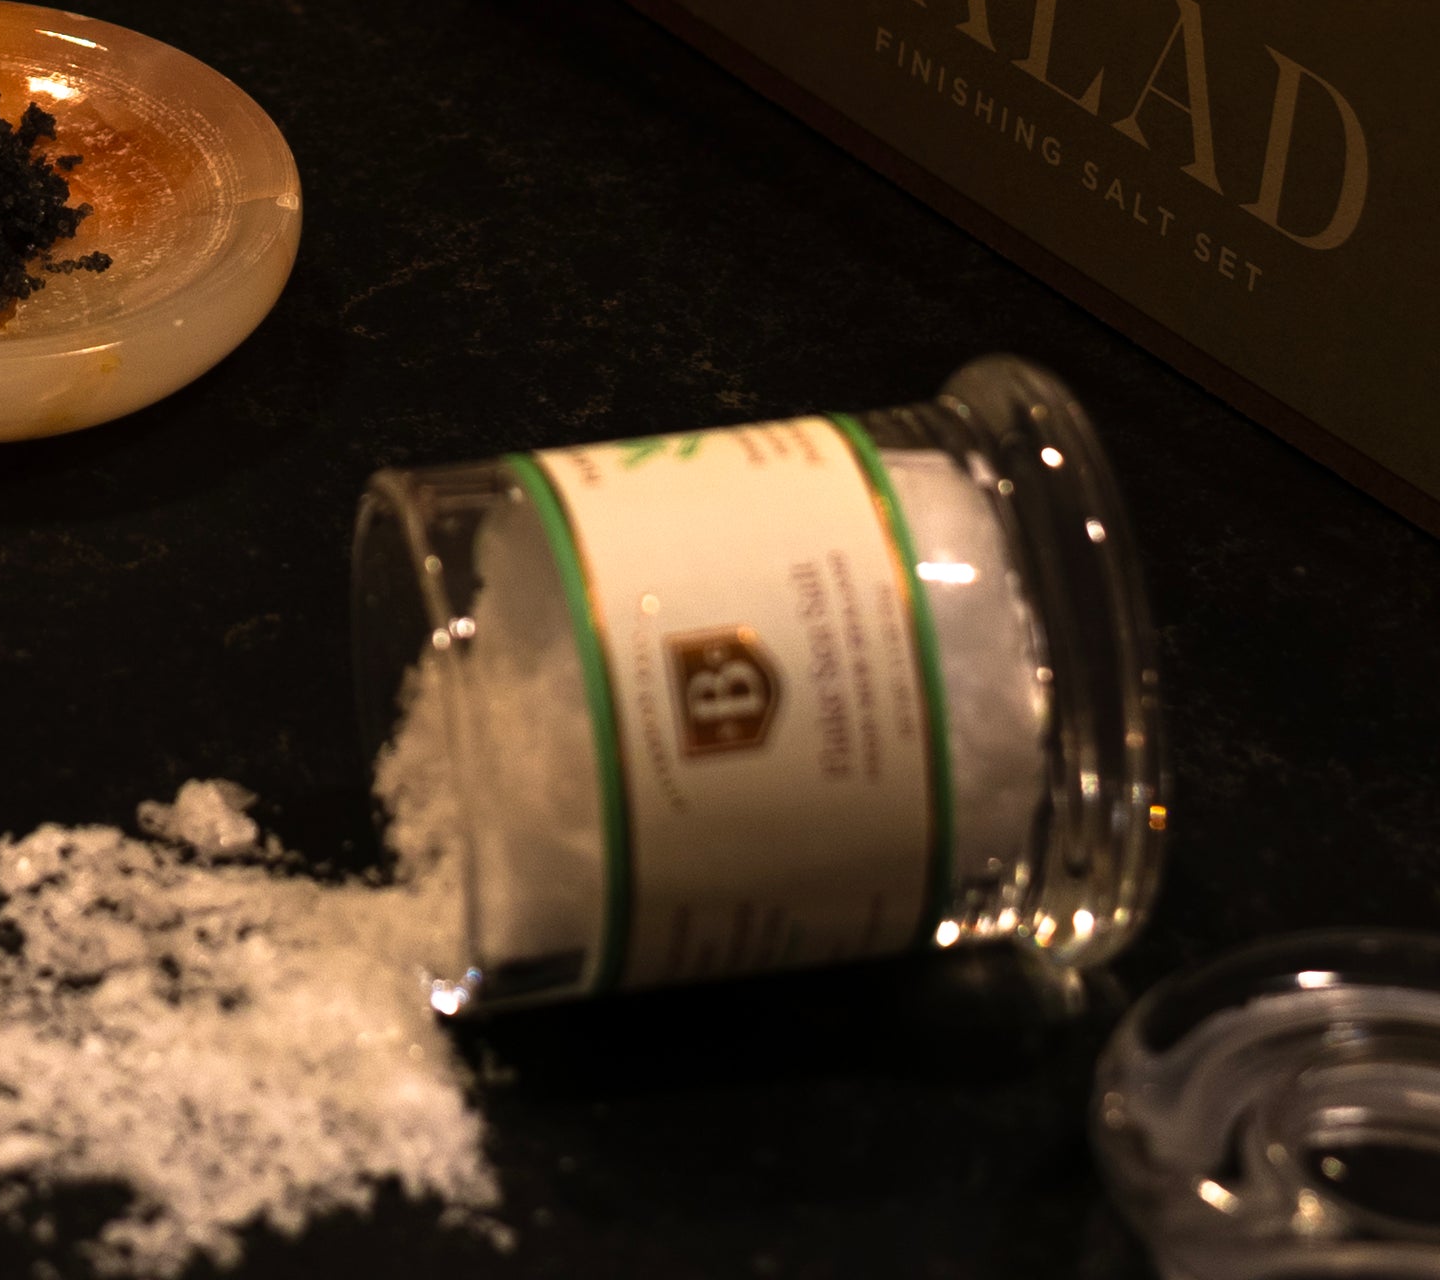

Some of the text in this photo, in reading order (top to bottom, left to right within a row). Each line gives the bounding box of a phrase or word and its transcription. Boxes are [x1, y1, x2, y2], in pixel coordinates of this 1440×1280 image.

[875, 26, 1263, 290] FINISHING SALT SET
